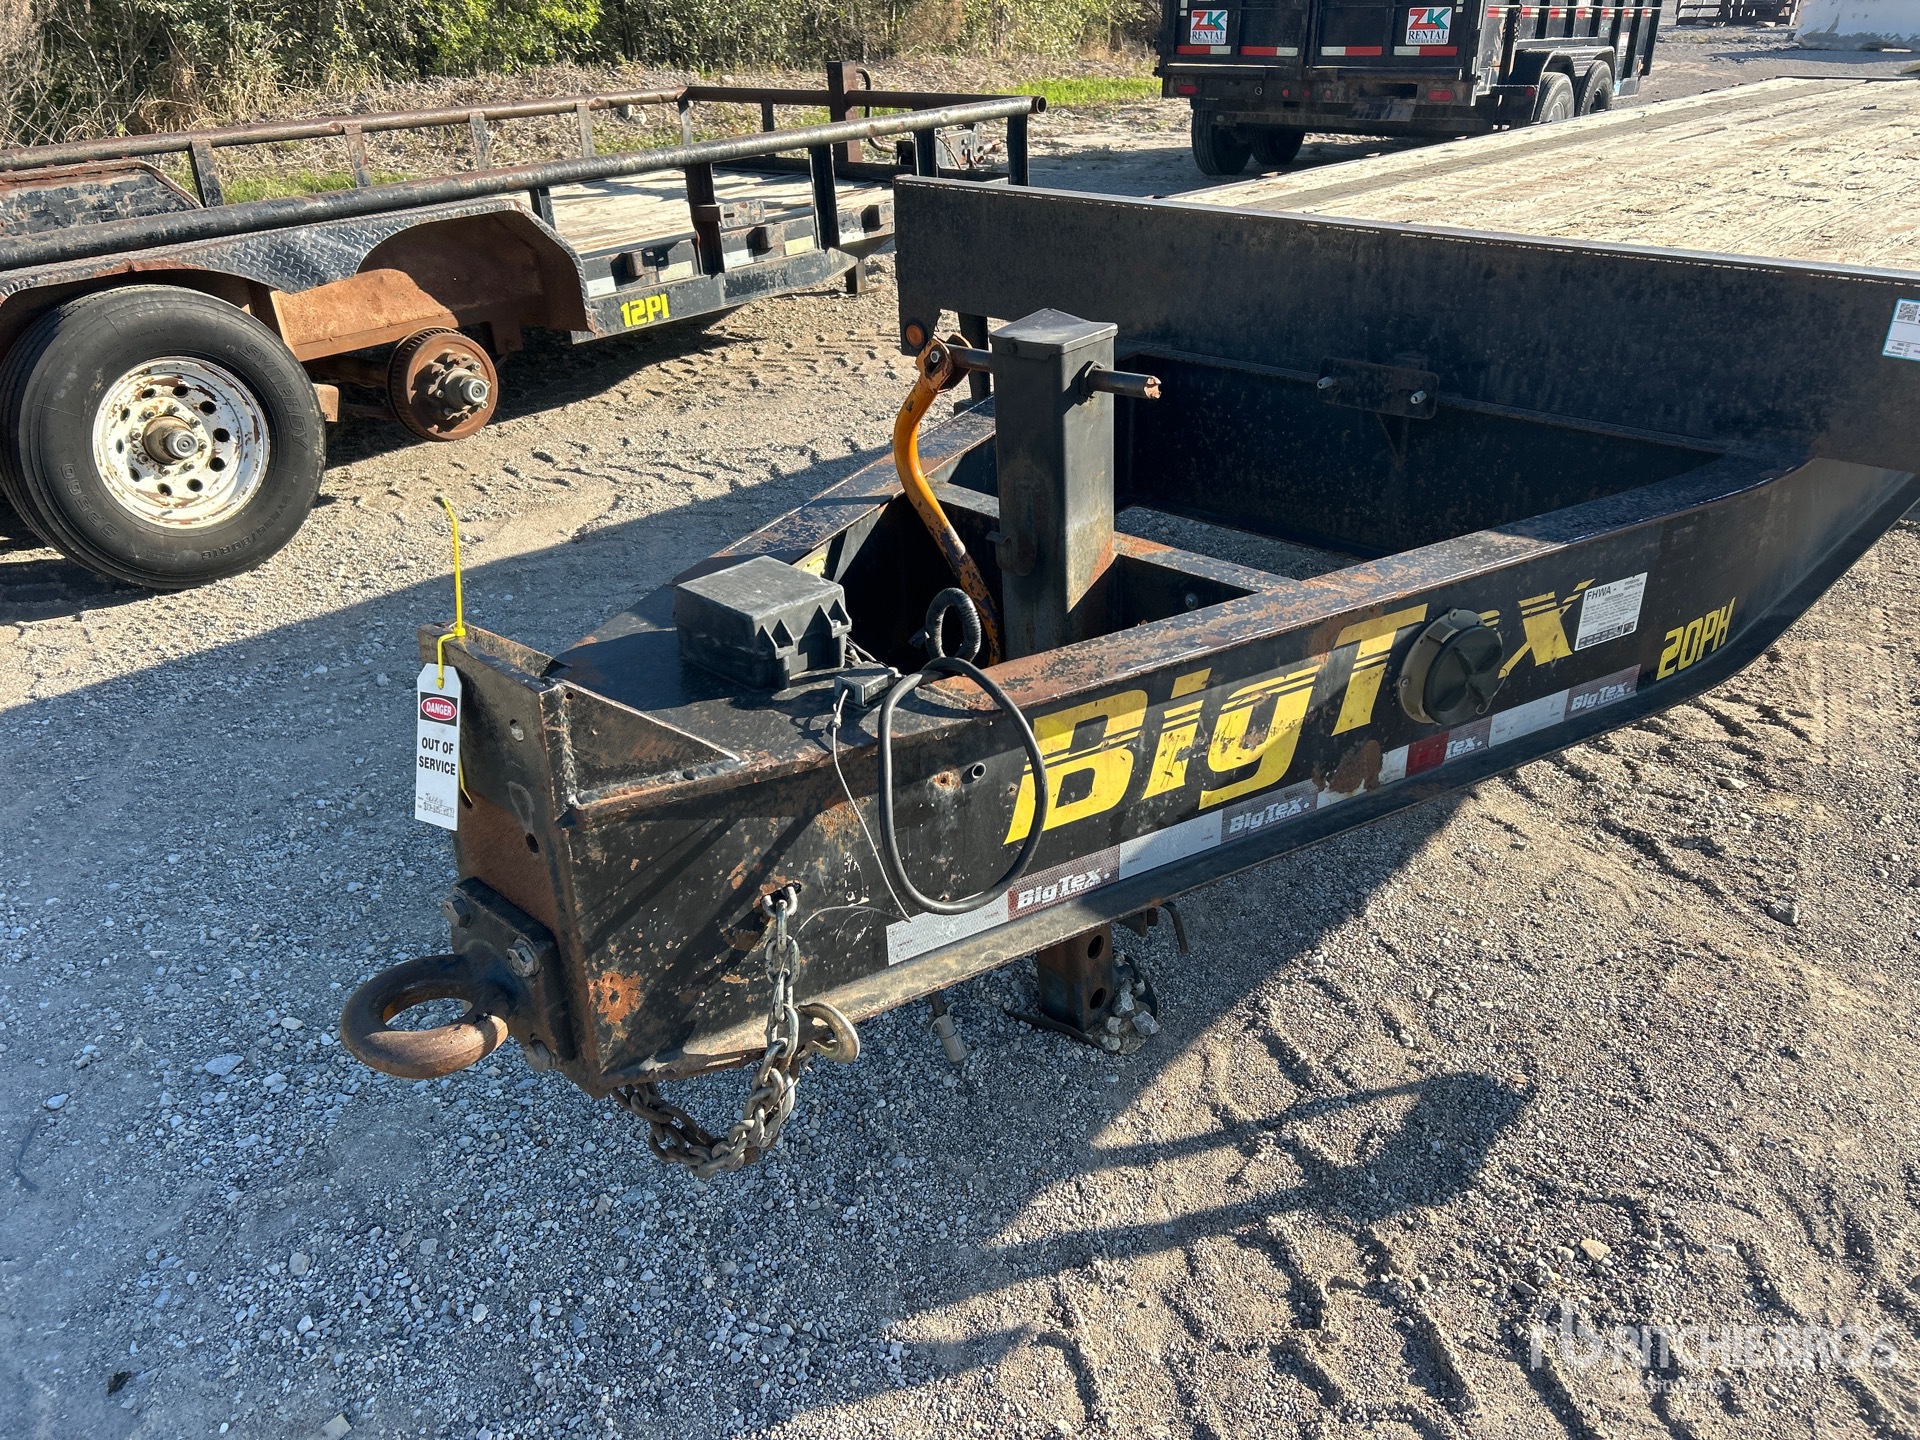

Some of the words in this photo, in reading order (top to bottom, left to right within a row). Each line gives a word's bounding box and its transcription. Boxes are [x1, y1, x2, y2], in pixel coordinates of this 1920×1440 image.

[1191, 11, 1227, 31] ZK
[1408, 8, 1450, 30] ZK
[1192, 31, 1225, 40] RENTAL
[1408, 30, 1448, 40] RENTAL
[240, 342, 309, 451] SYNERGY
[1586, 585, 1612, 601] FHWA
[1656, 596, 1736, 681] 20PH
[1332, 579, 1595, 737] Tx
[426, 701, 452, 717] DANGER
[421, 737, 440, 752] OUT
[442, 741, 454, 755] OF
[418, 755, 456, 776] SERVICE
